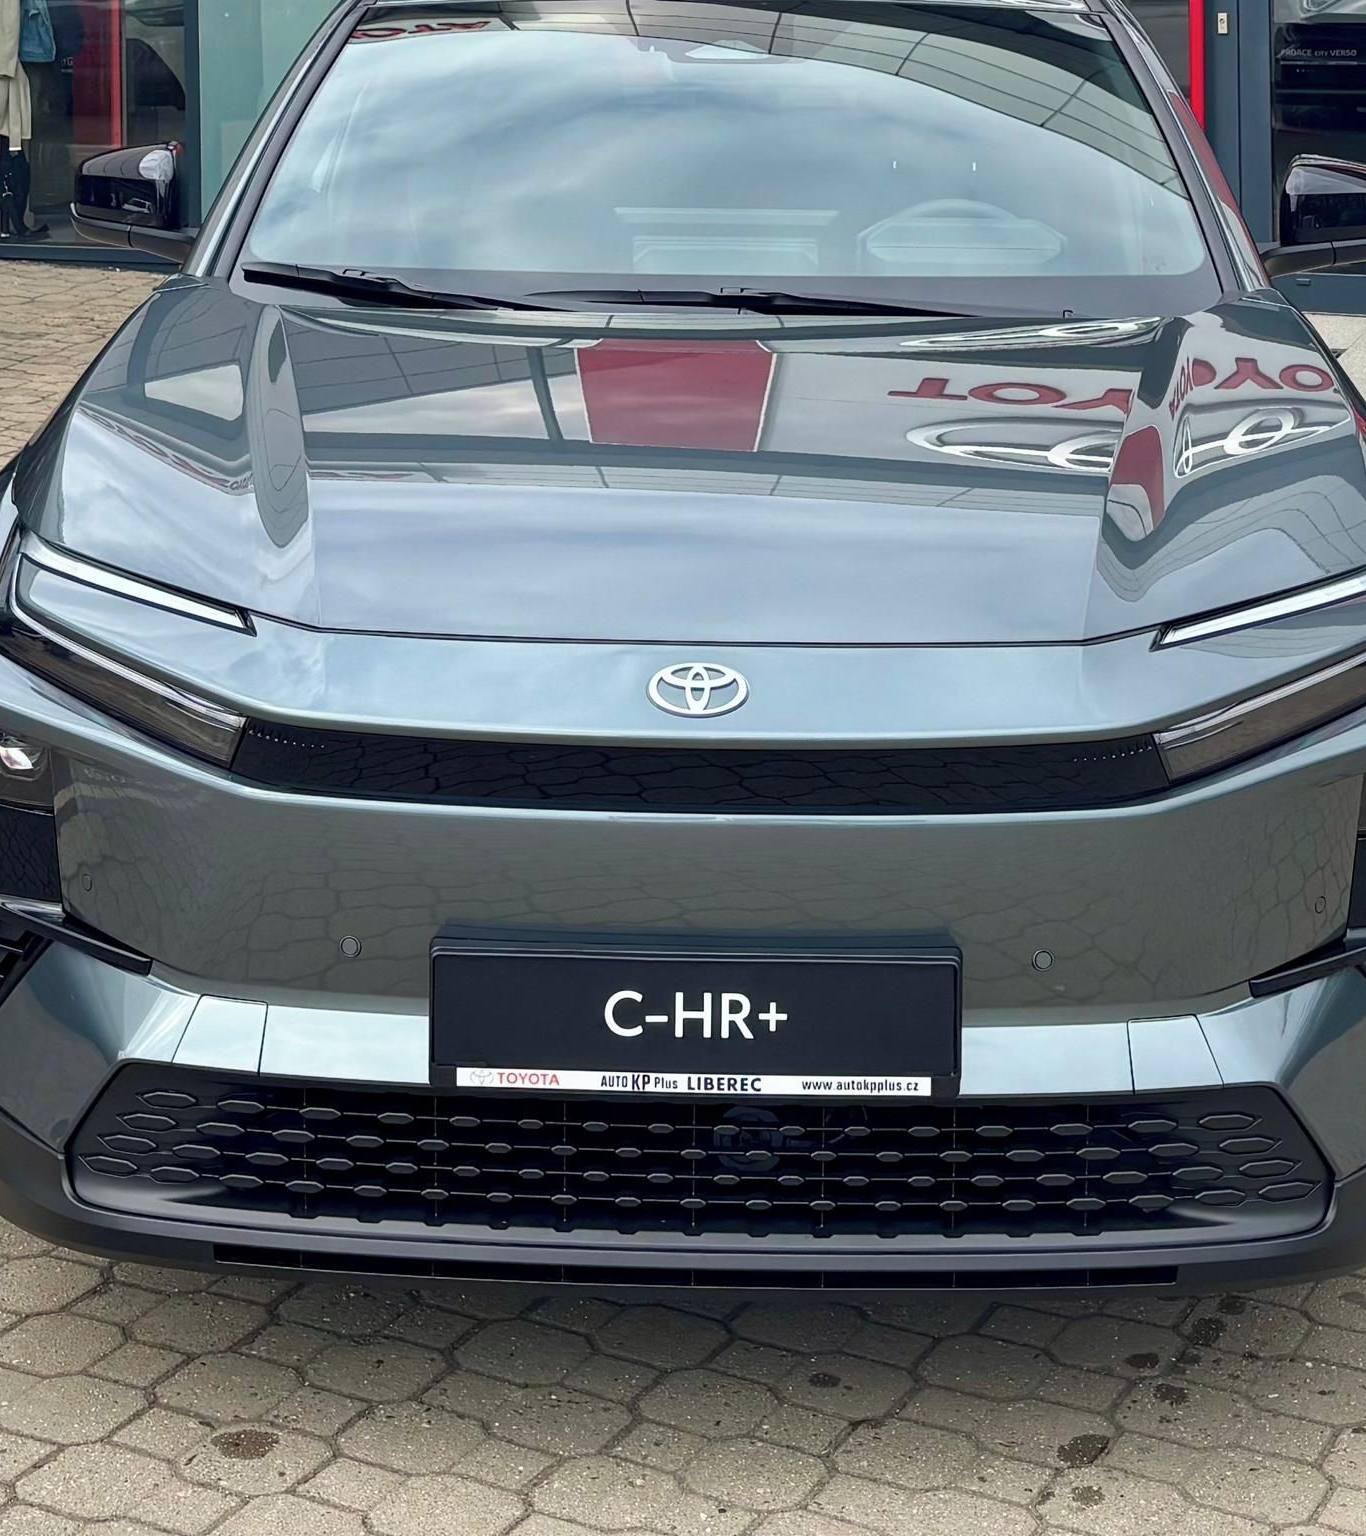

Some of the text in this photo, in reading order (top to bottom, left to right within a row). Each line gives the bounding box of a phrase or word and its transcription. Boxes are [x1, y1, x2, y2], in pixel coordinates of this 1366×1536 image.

[1329, 49, 1357, 57] VERSO
[603, 990, 788, 1040] C-HR+
[497, 1071, 920, 1093] TOYOTA AUTO KP Plus LIBEREC www.autokpplus.cz
